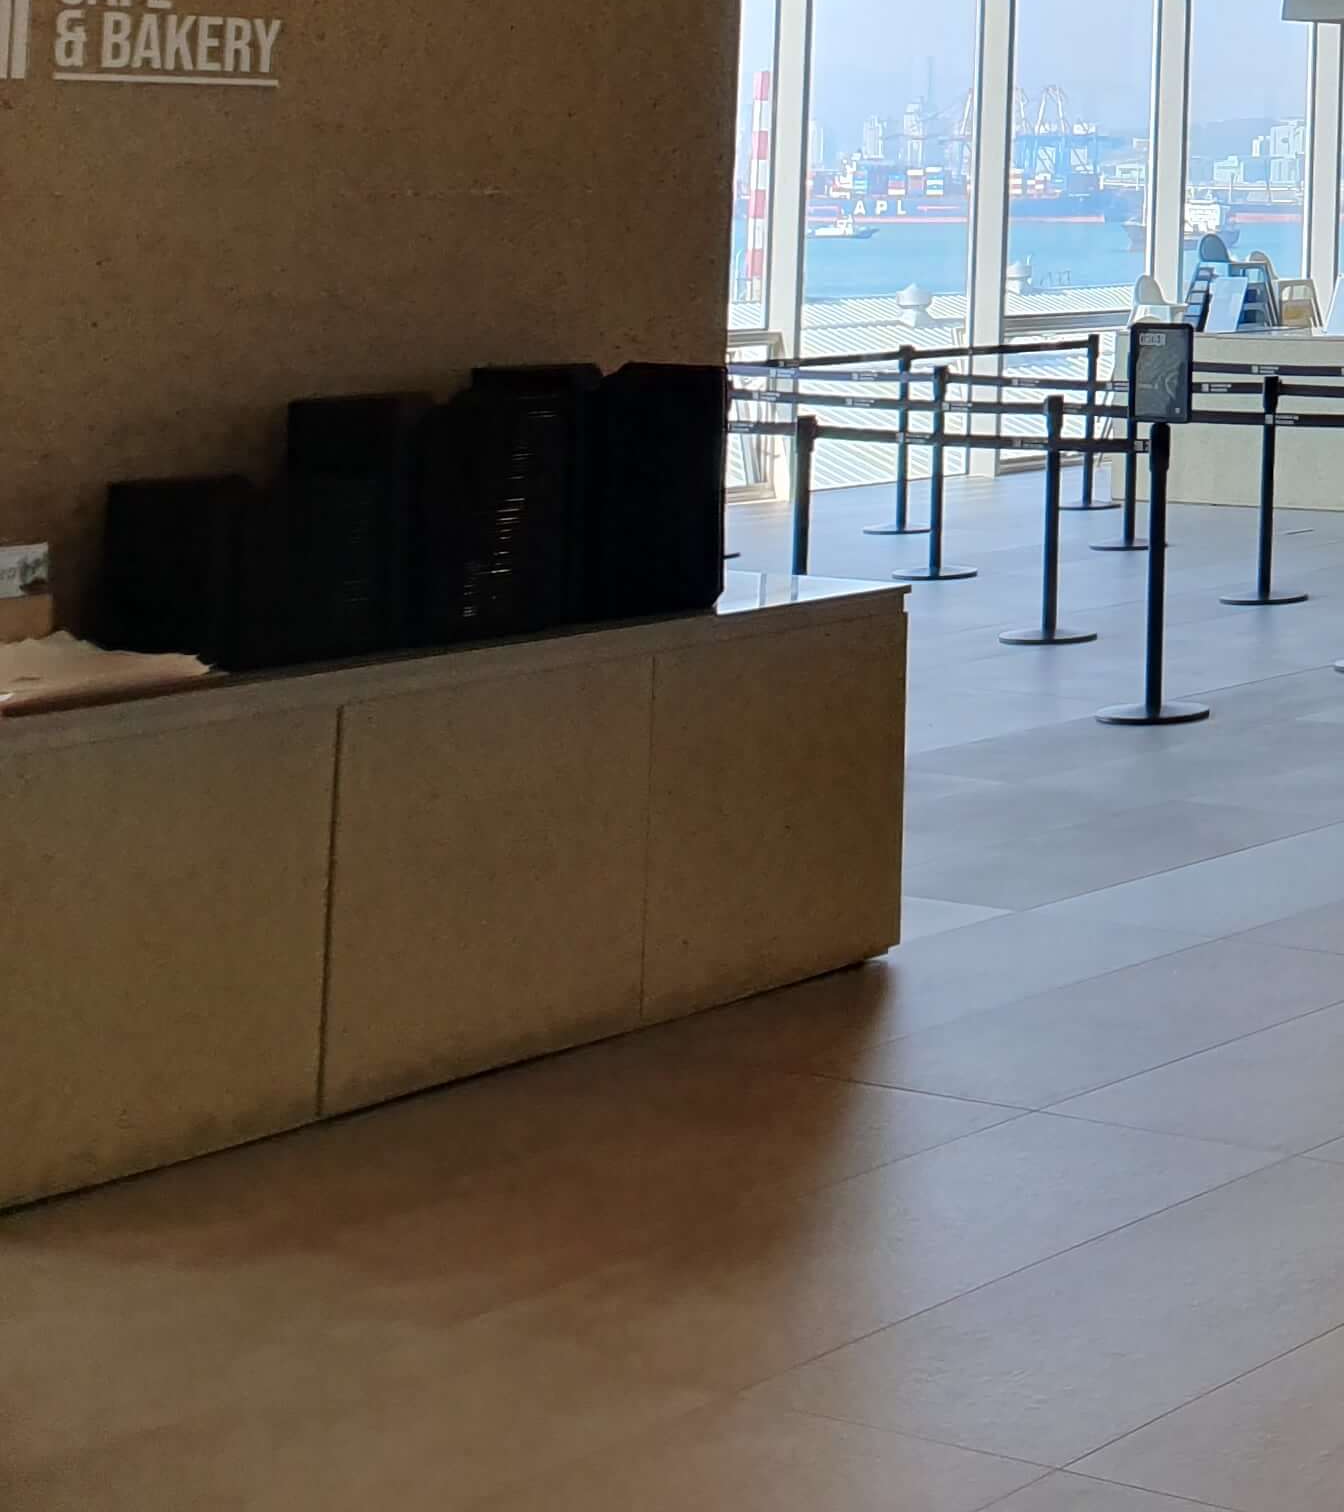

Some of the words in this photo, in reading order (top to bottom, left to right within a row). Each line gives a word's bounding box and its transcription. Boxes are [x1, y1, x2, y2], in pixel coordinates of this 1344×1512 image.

[54, 9, 87, 67] &
[101, 11, 282, 73] BAKERY
[853, 199, 907, 216] APL
